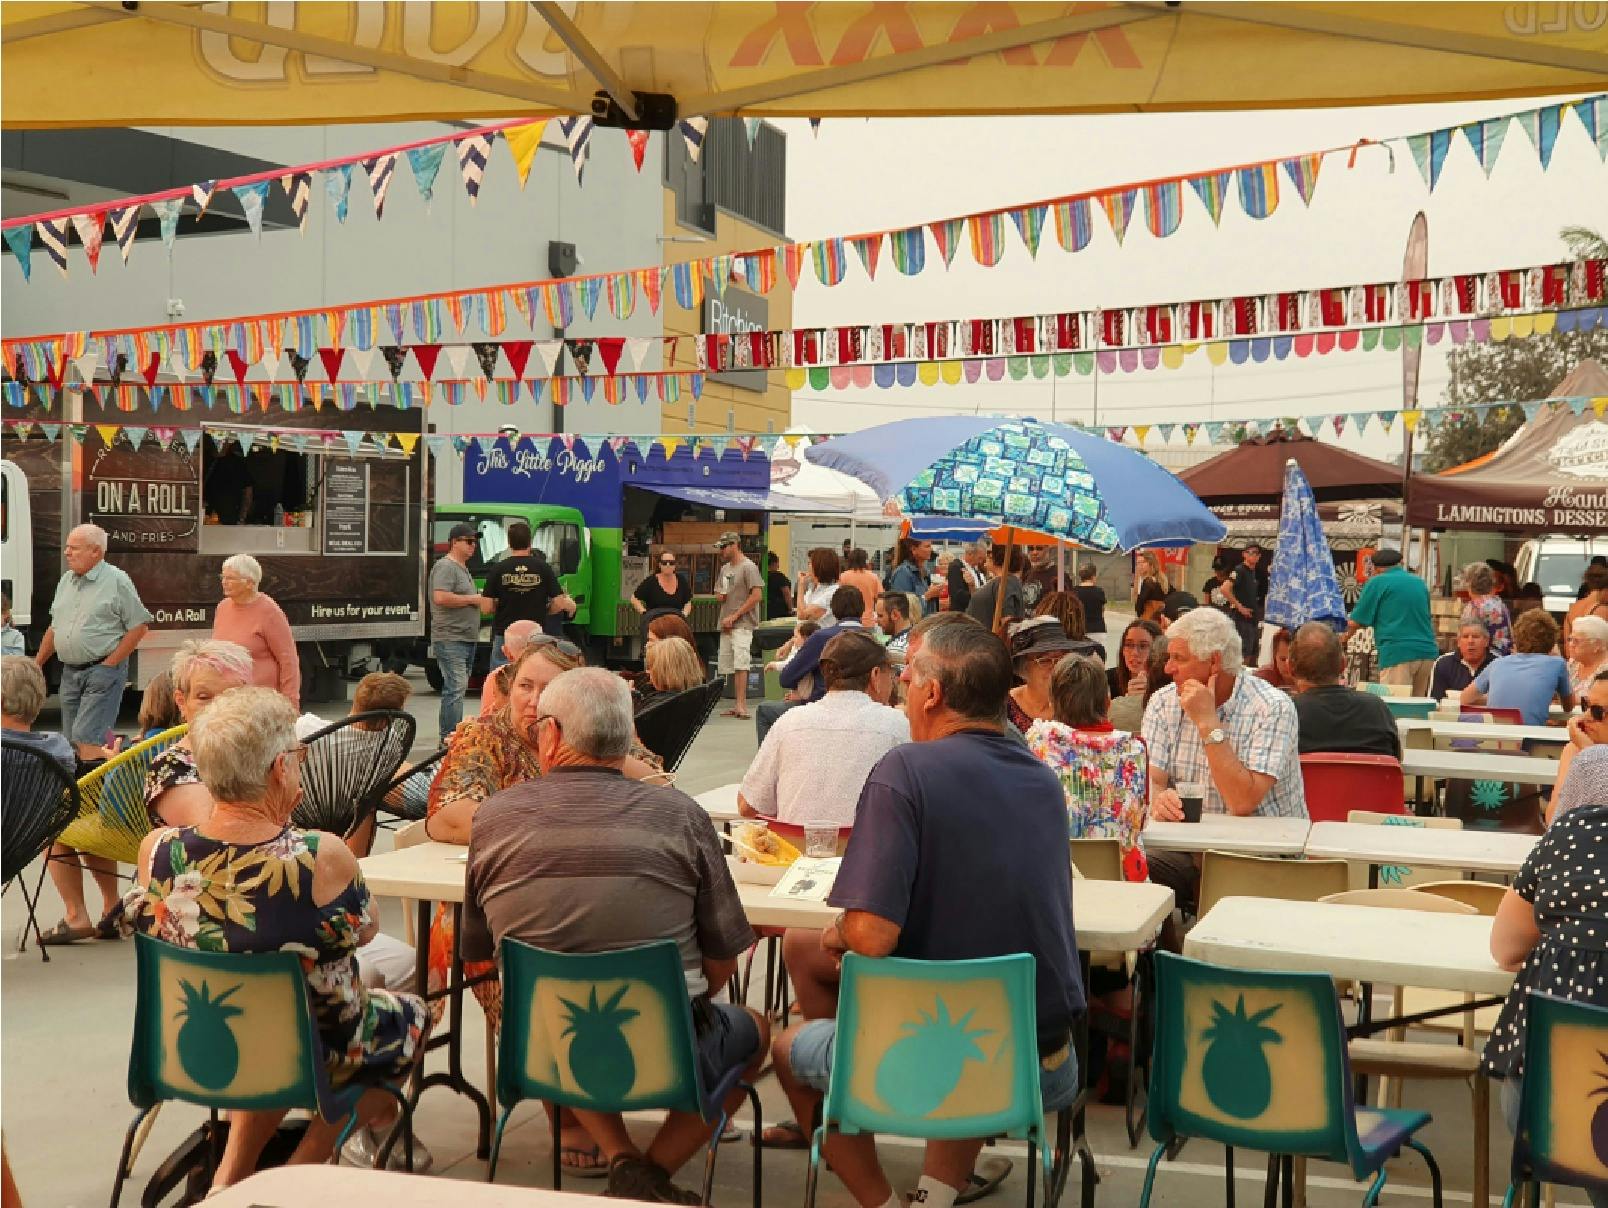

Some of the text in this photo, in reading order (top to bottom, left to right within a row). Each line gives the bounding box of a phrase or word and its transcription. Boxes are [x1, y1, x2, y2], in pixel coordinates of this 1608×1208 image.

[477, 448, 605, 483] This Little Piggie
[97, 481, 191, 515] ON A ROLL
[1437, 503, 1549, 527] LAMINGTONS,
[112, 529, 176, 543] AND FRIES
[156, 608, 206, 622] On A Roll
[311, 603, 411, 618] Hire us for your event
